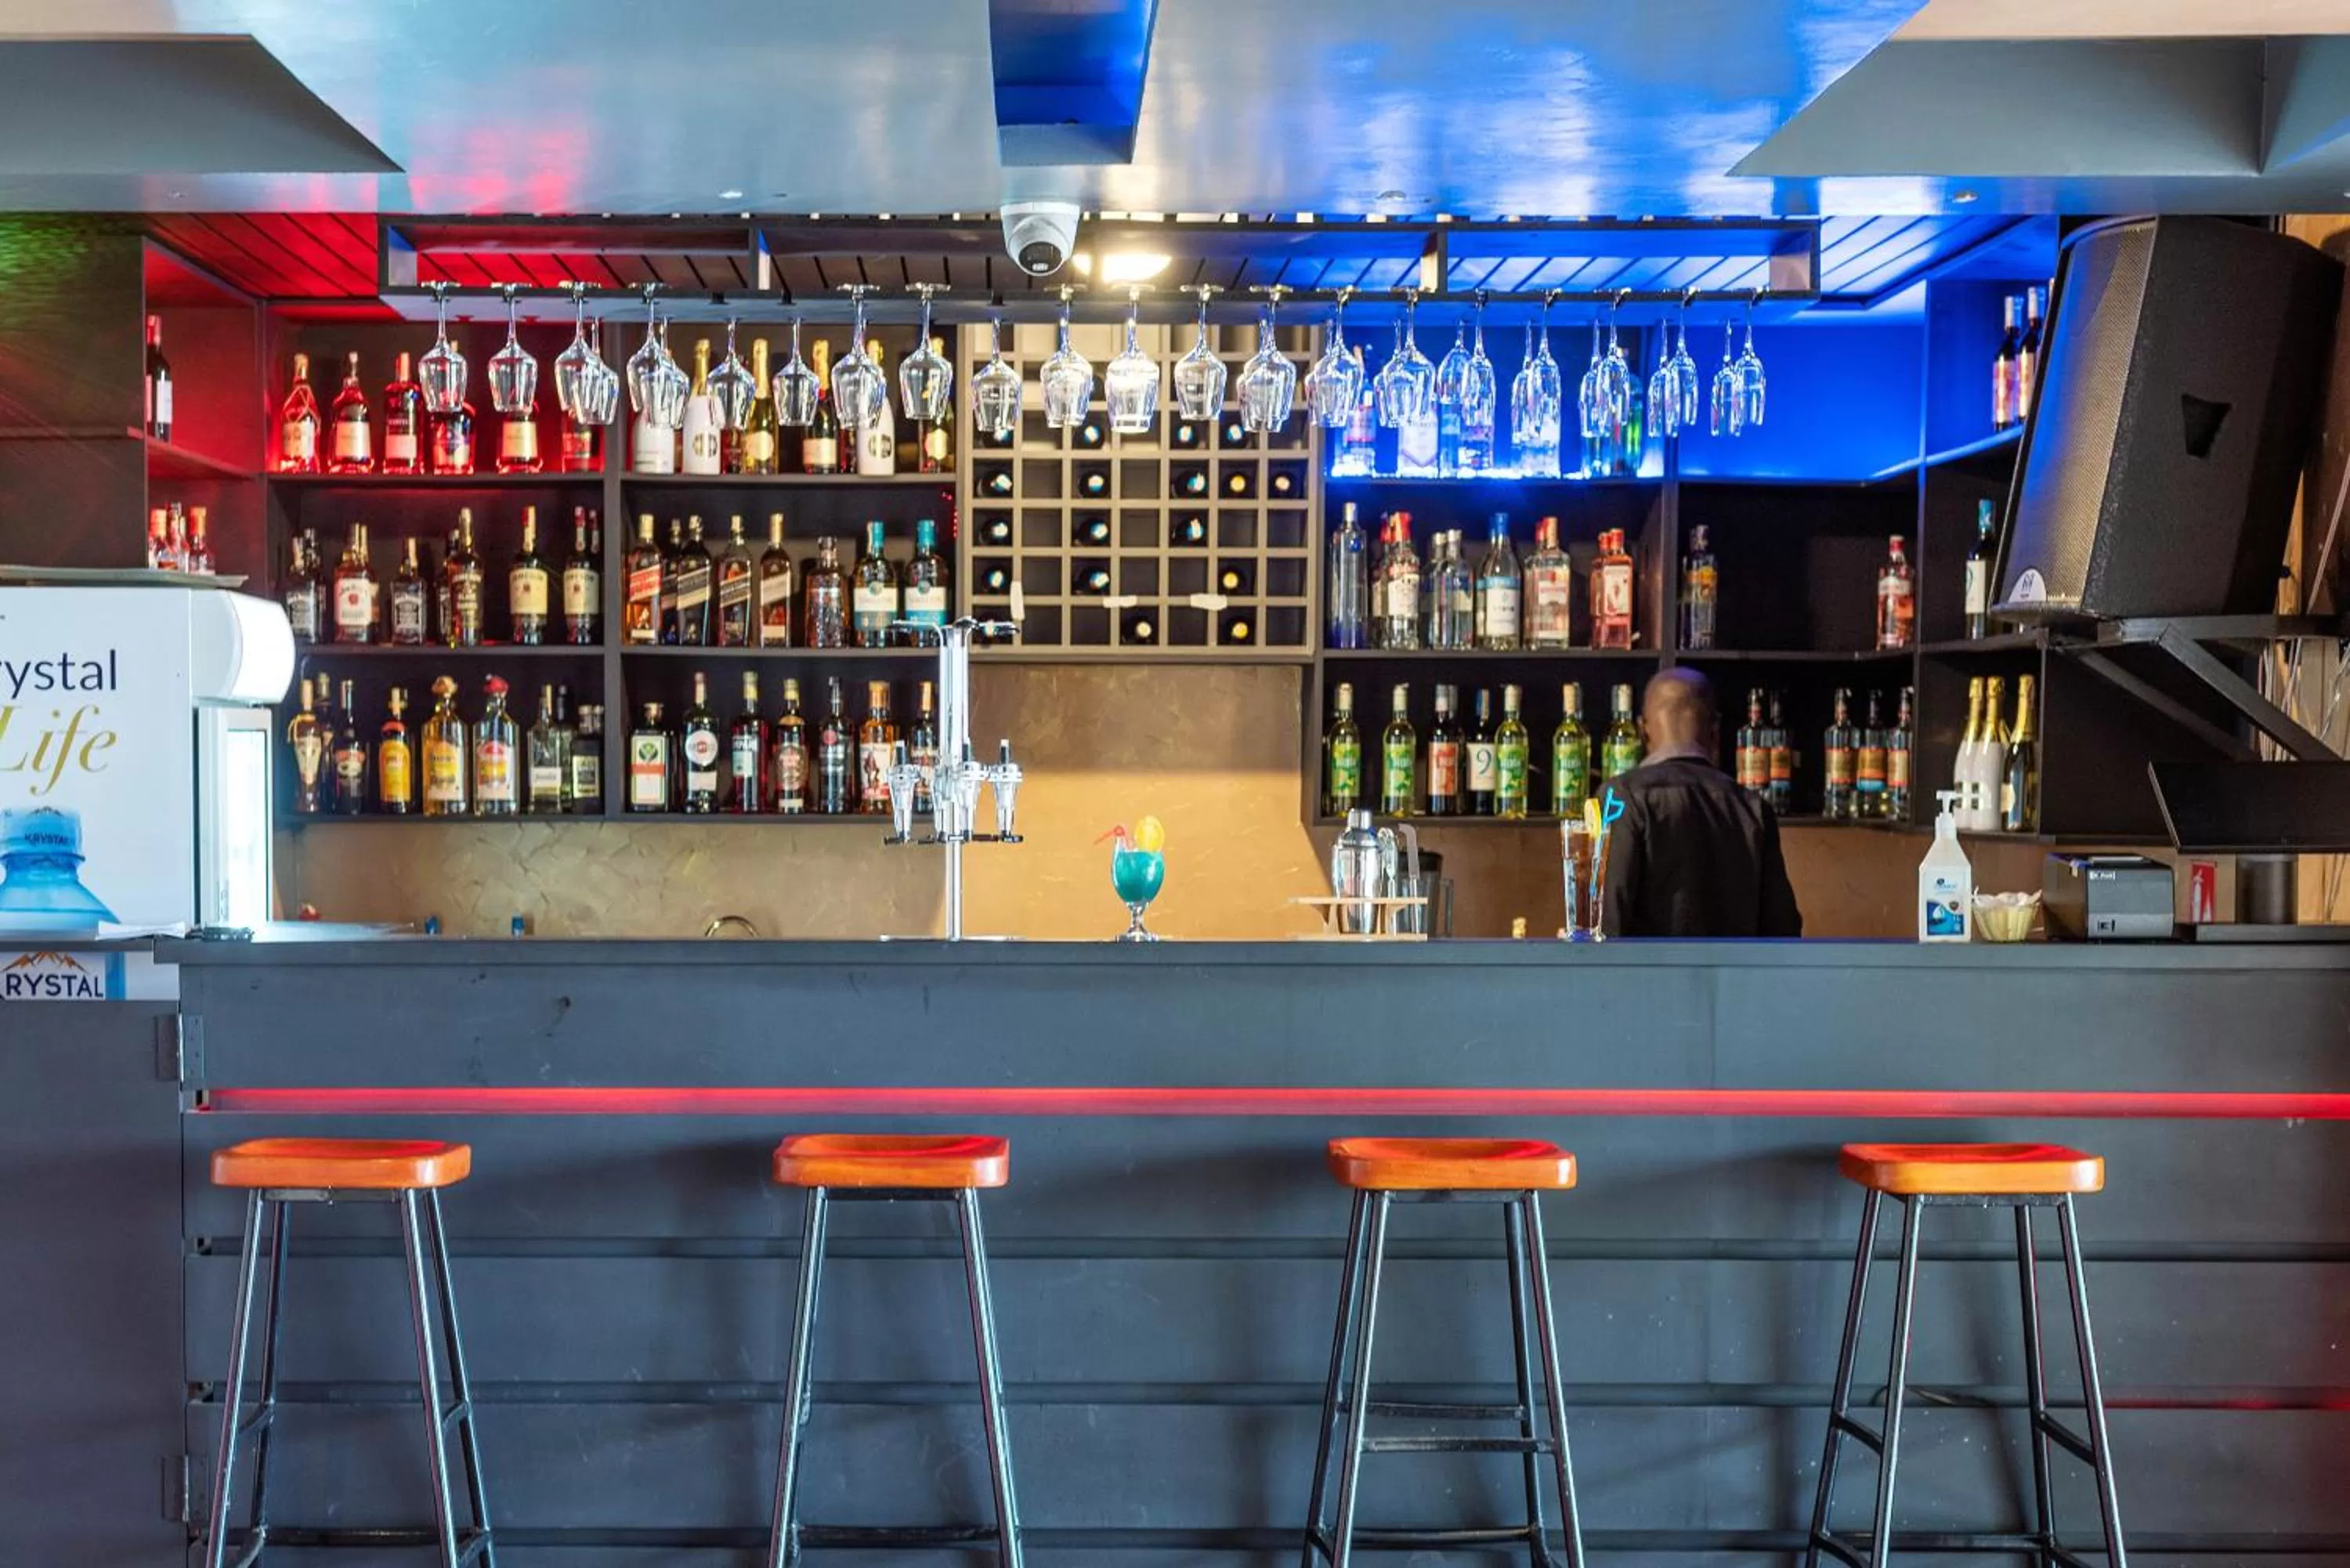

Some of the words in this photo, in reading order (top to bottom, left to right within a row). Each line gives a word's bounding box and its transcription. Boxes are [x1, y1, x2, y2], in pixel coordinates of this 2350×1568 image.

[0, 649, 117, 699] ystal
[0, 704, 117, 796] Life
[1477, 750, 1491, 775] 9
[0, 974, 103, 999] RYSTAL
